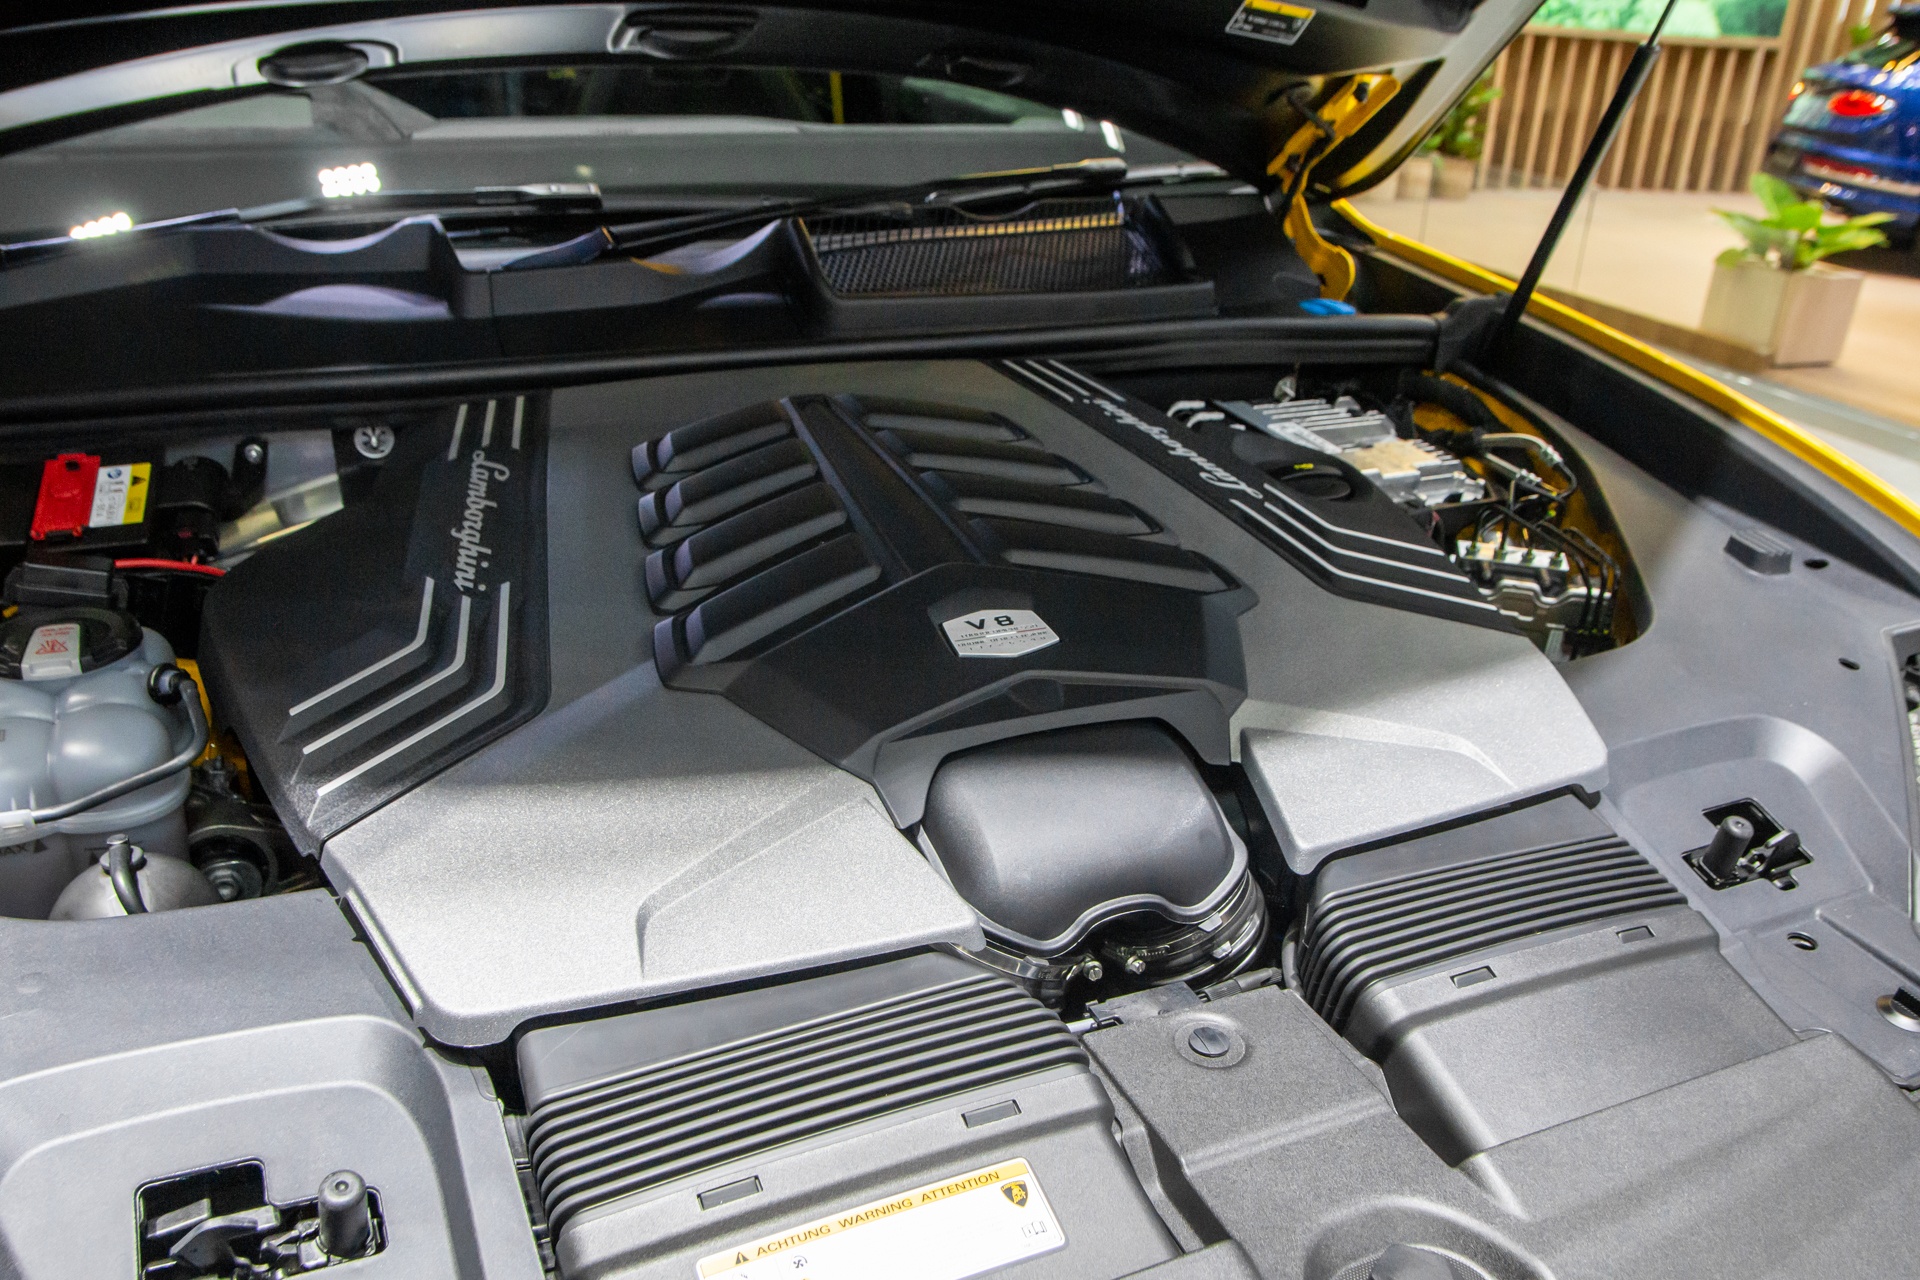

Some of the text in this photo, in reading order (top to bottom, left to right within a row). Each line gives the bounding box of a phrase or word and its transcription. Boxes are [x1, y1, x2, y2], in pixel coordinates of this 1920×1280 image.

[1083, 397, 1264, 499] Lamborghini
[450, 449, 510, 592] Lamborghini
[756, 1224, 831, 1257] ACHTUNG
[837, 1197, 914, 1228] WARNING
[920, 1171, 1001, 1203] ATTENTION
